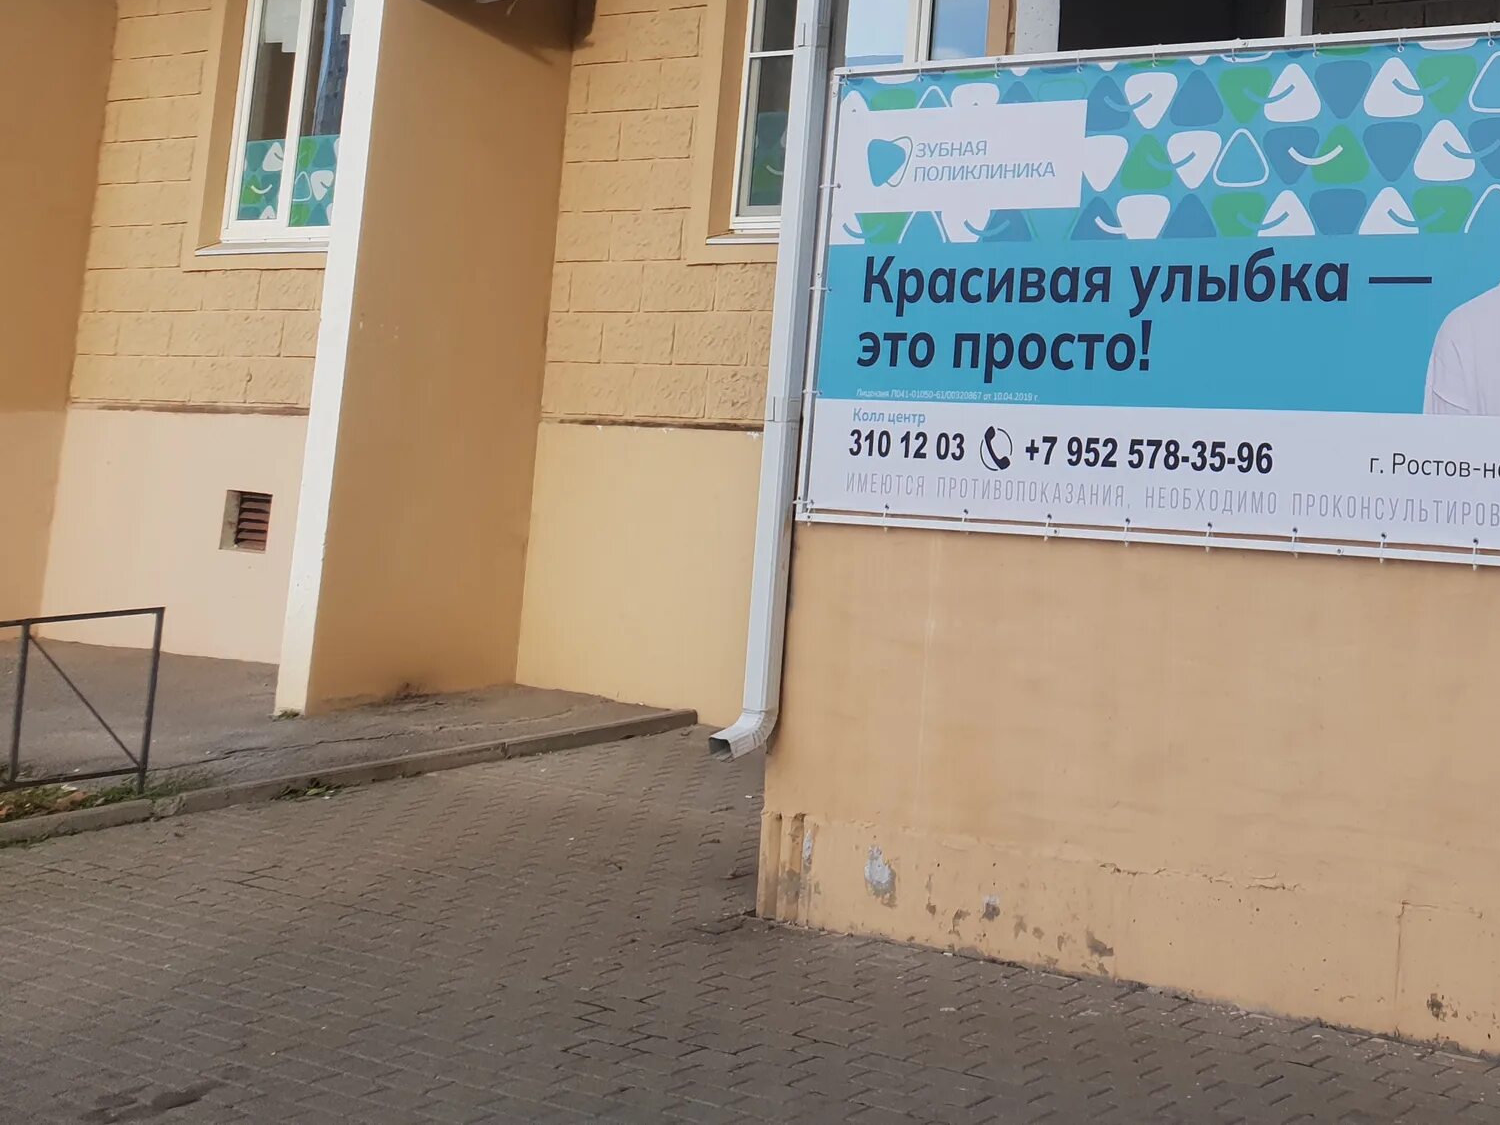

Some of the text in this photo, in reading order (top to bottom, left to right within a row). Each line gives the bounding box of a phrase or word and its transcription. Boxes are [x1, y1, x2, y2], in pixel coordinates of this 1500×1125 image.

[915, 139, 988, 159] ЗУБНАЯ
[913, 161, 1056, 183] ПОЛИКЛИНИКА
[863, 255, 1112, 318] Красивая
[1128, 246, 1350, 319] улыбка
[856, 319, 1153, 384] это просто!
[983, 392, 993, 401] от
[852, 407, 926, 428] Колл центр
[848, 428, 966, 461] 310 12 03
[1025, 435, 1274, 475] +7 952 578-35-96
[1369, 456, 1385, 474] г.
[844, 472, 926, 498] ИМЕЮТСЯ
[935, 475, 1131, 510] ПРОТИВОПОКАЗАНИЯ,
[1144, 485, 1278, 516] НЕОБХОДИМО
